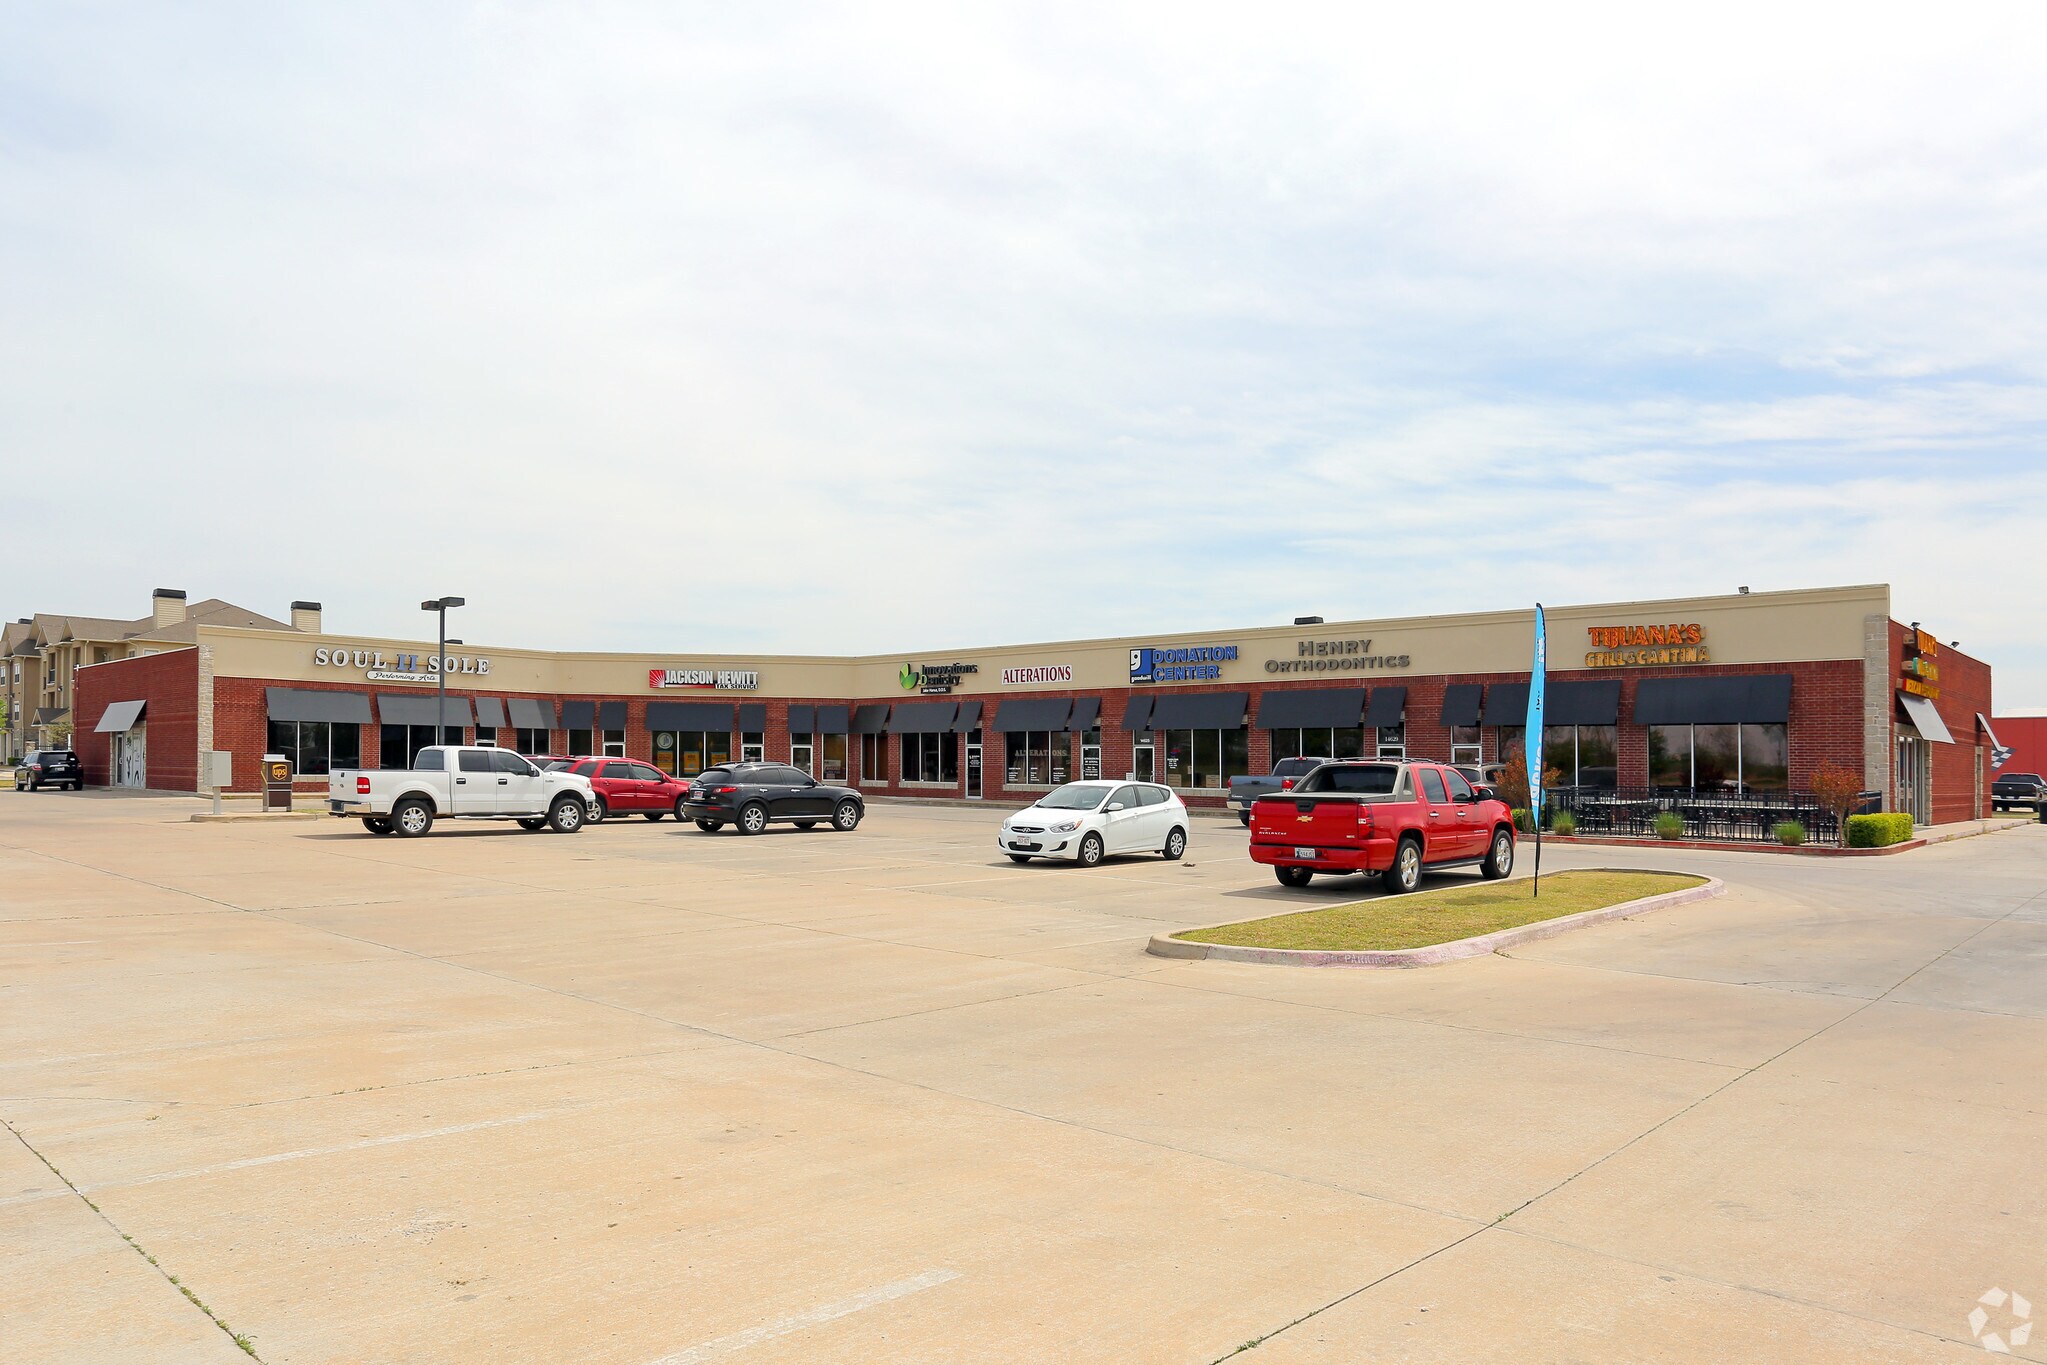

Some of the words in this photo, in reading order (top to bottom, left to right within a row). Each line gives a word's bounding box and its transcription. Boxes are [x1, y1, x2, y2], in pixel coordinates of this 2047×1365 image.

[1588, 624, 1701, 650] TIJUANA'S
[1153, 645, 1238, 664] DONATION
[1298, 639, 1372, 656] HENRY
[315, 648, 387, 669] SOUL
[396, 653, 418, 671] II
[427, 655, 490, 675] SOLE
[1264, 655, 1410, 673] ORTHODONTICS
[1585, 651, 1626, 667] GRILL
[1636, 646, 1710, 664] CANTINA
[374, 672, 415, 681] Performing
[921, 662, 978, 675] Innovations
[1003, 666, 1071, 683] ALTERATIONS
[1153, 665, 1220, 681] CENTER
[665, 670, 713, 684] JACKSON
[716, 670, 758, 685] HEWITT
[921, 674, 960, 686] Dentistry
[1131, 674, 1152, 683] goodwill
[274, 768, 287, 778] ups
